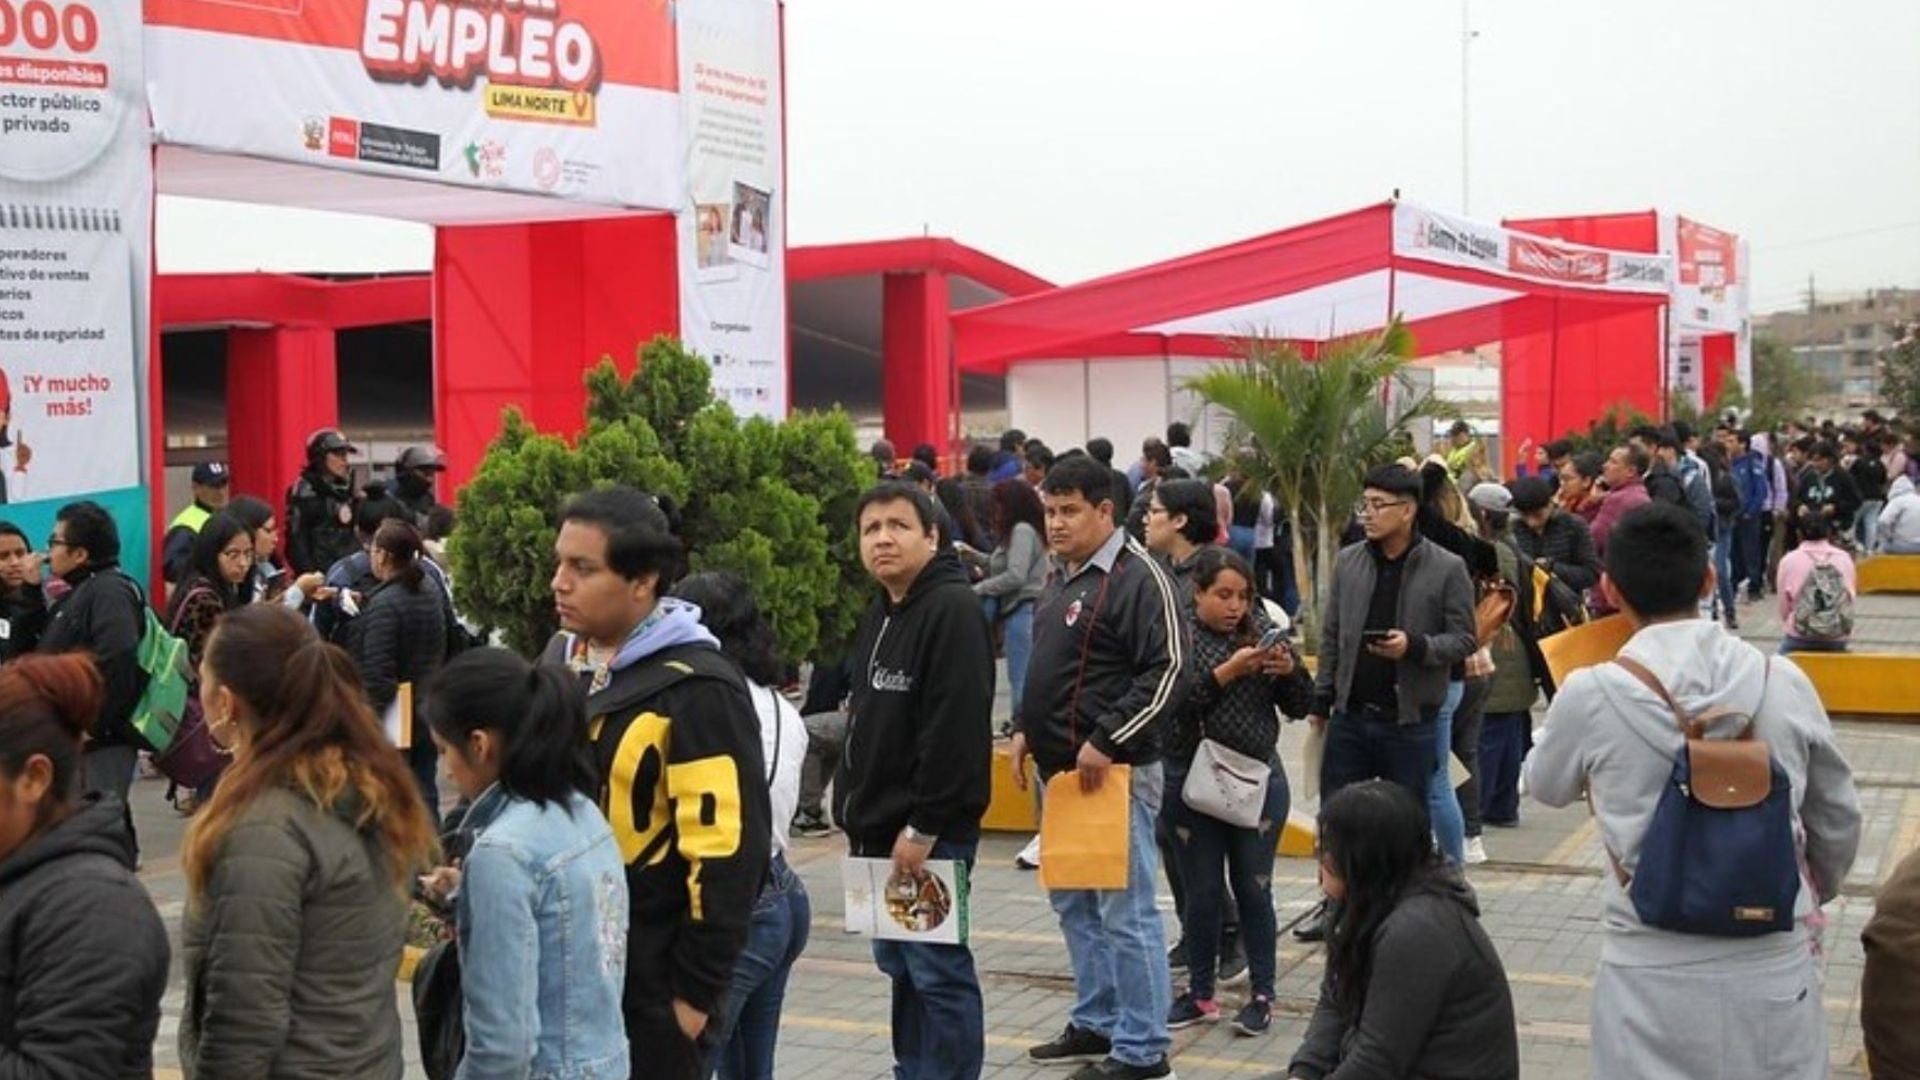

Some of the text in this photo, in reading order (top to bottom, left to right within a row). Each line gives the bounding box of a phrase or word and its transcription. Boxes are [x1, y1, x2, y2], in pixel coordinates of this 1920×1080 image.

[362, 0, 594, 82] EMPLEO
[17, 62, 104, 83] disponibles
[1, 93, 101, 113] ctor público
[493, 92, 567, 114] LIMA NORTE
[3, 115, 71, 135] privado
[29, 268, 45, 281] de
[48, 270, 90, 282] ventas
[23, 328, 39, 341] de
[42, 328, 105, 344] seguridad
[23, 373, 111, 393] ¡Y mucho
[46, 397, 92, 417] más!
